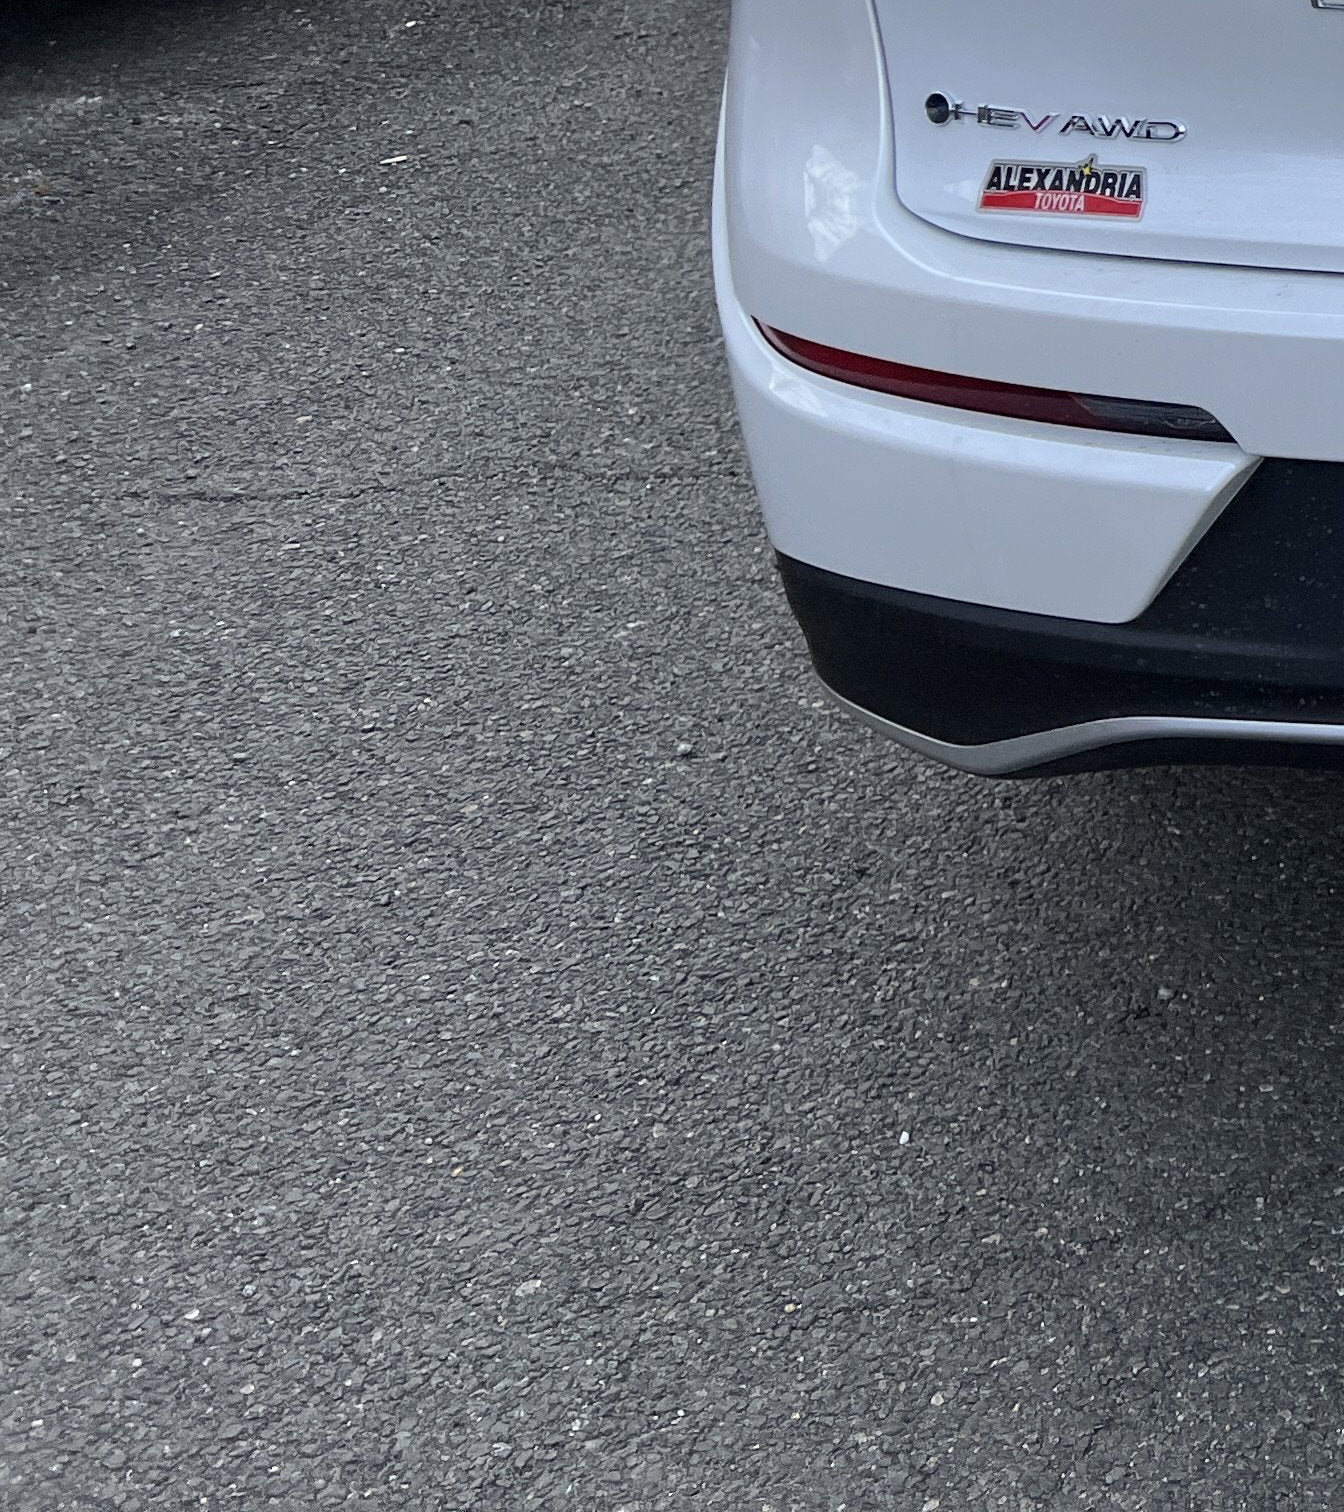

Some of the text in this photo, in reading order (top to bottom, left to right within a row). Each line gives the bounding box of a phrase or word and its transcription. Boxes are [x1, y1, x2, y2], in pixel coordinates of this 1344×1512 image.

[952, 99, 1188, 142] HEV AWD
[985, 164, 1143, 199] ALEXANDRIA
[1034, 192, 1086, 212] TOYOTA
